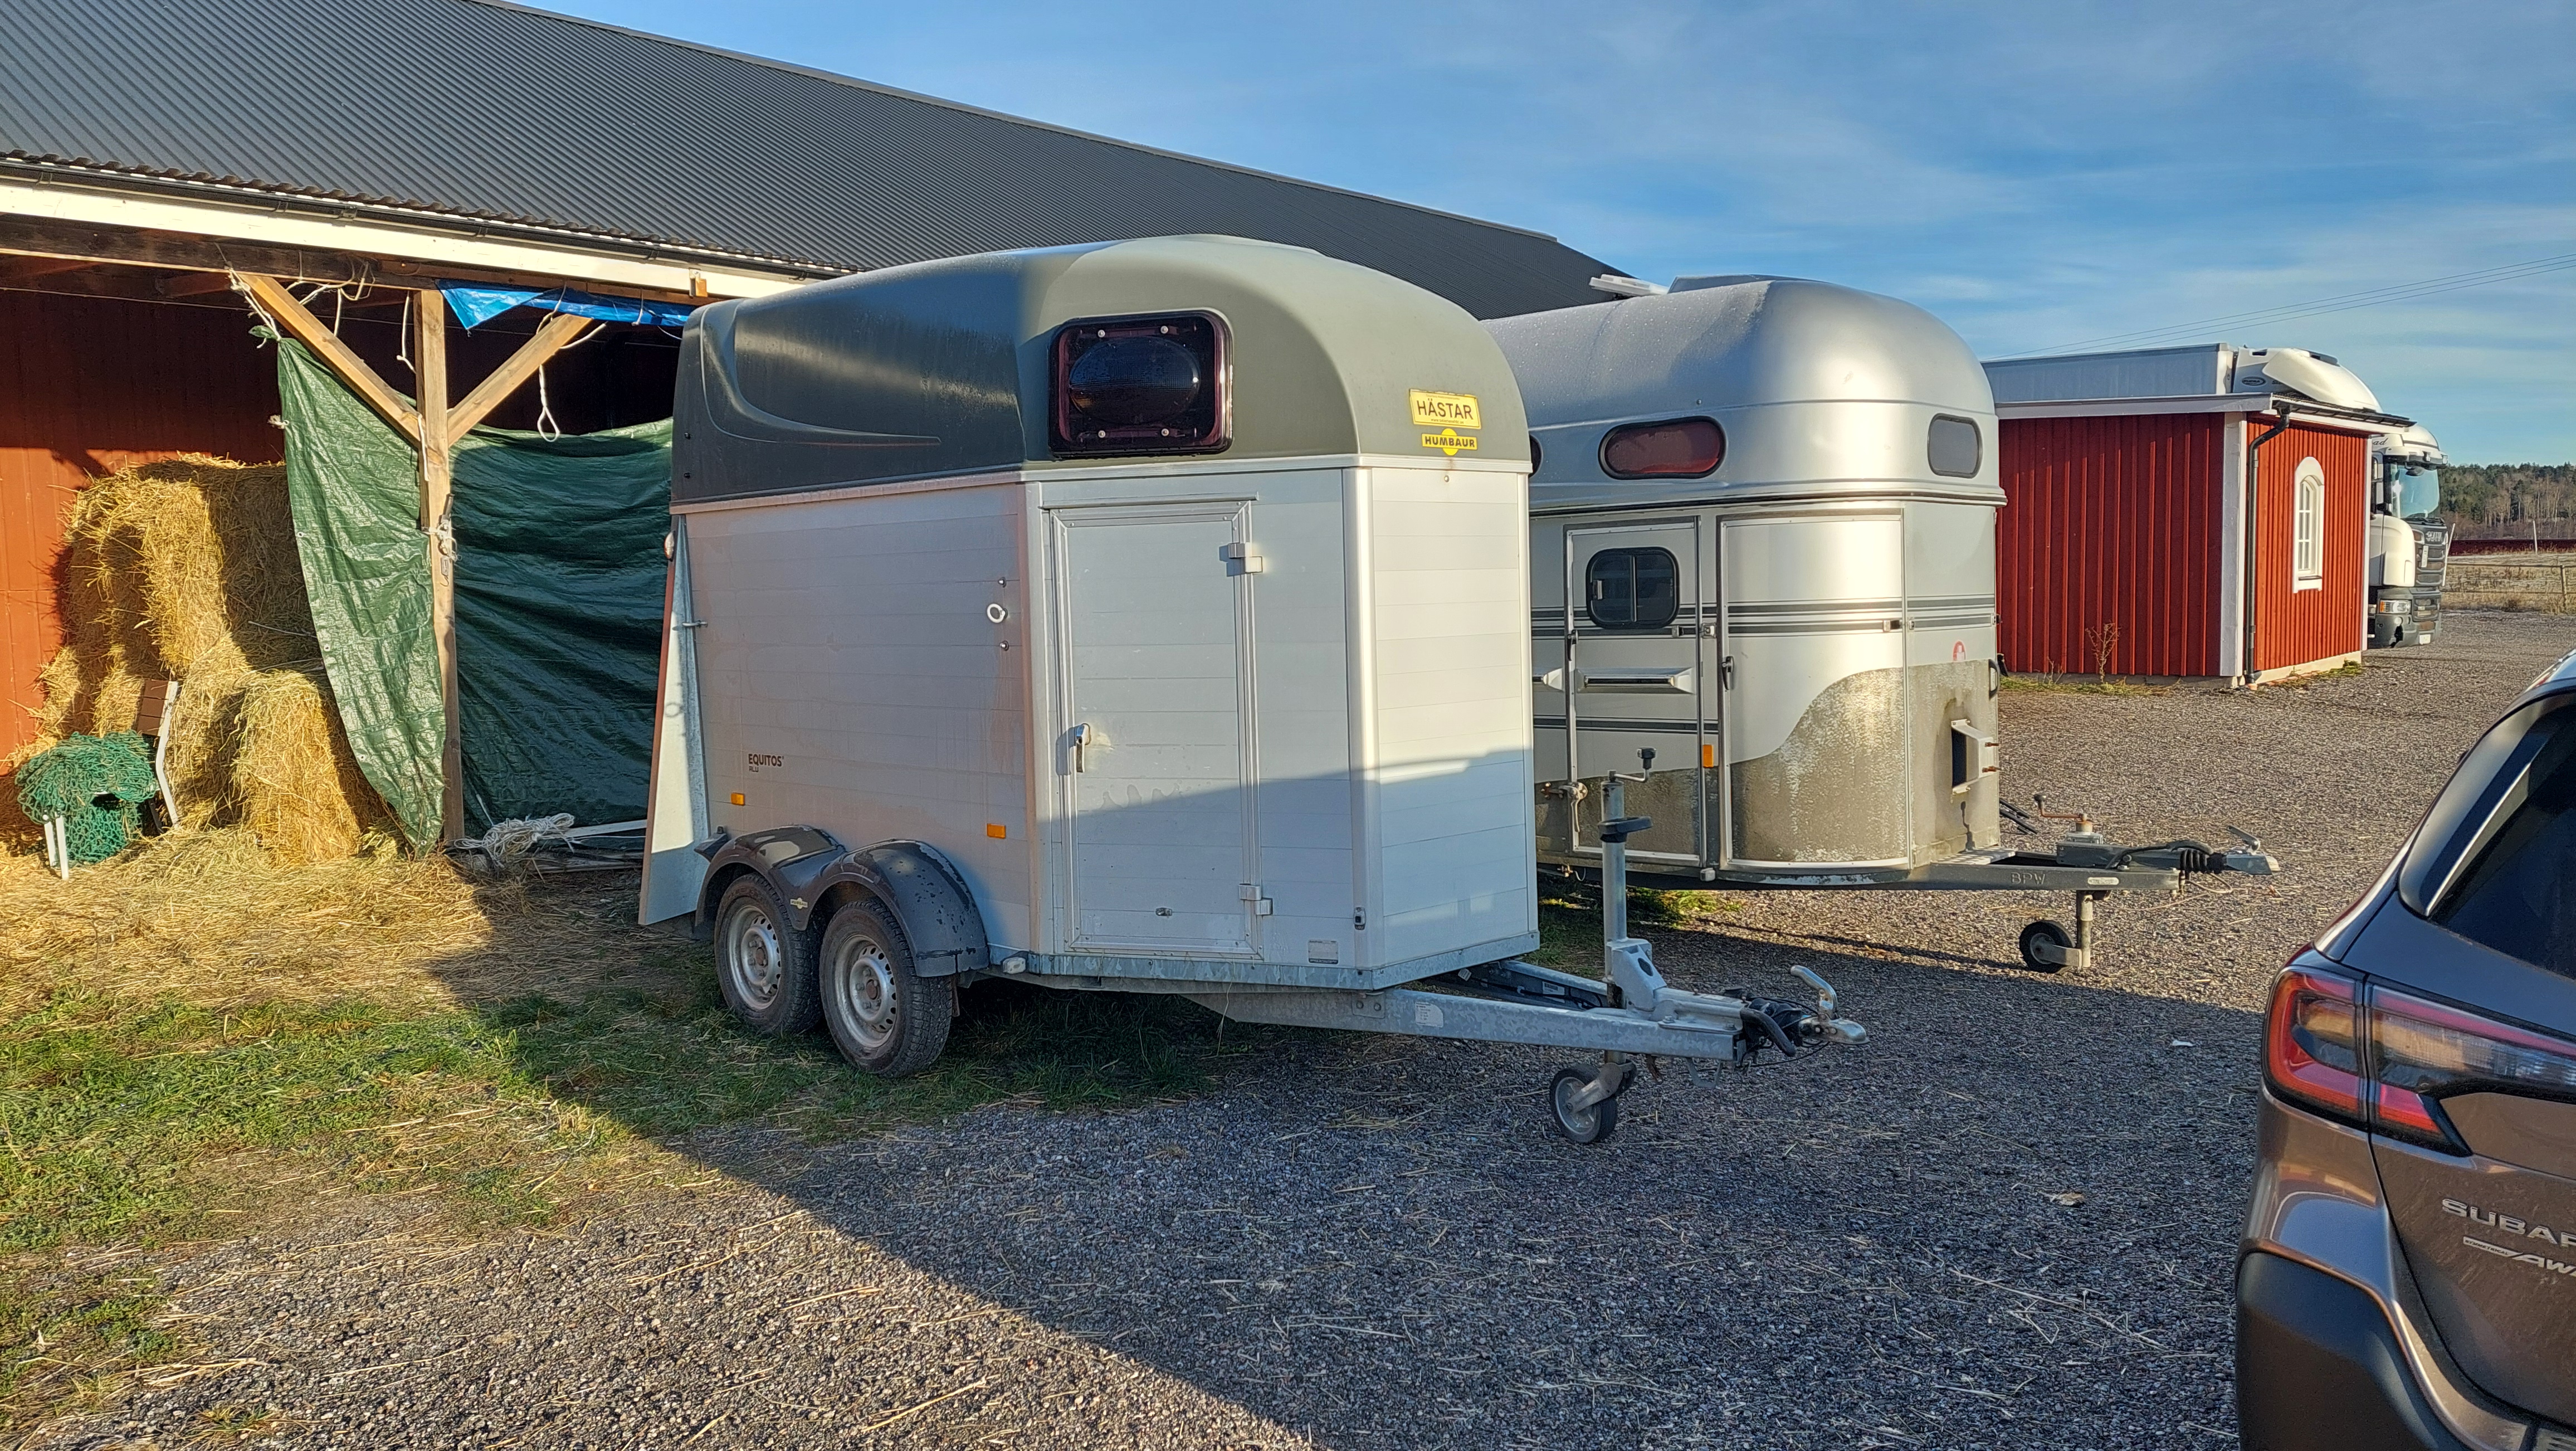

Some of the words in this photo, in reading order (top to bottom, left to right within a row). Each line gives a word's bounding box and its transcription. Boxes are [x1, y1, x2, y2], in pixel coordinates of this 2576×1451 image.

[1416, 398, 1474, 420] HÄSTAR
[1424, 436, 1475, 447] HUMBAUR
[2372, 437, 2388, 446] ad
[748, 753, 782, 767] EQUITOS
[2011, 872, 2045, 885] BPW
[2442, 1198, 2576, 1248] SUBAR
[2465, 1239, 2509, 1255] SYMMETRICAL
[2513, 1254, 2576, 1277] AW
